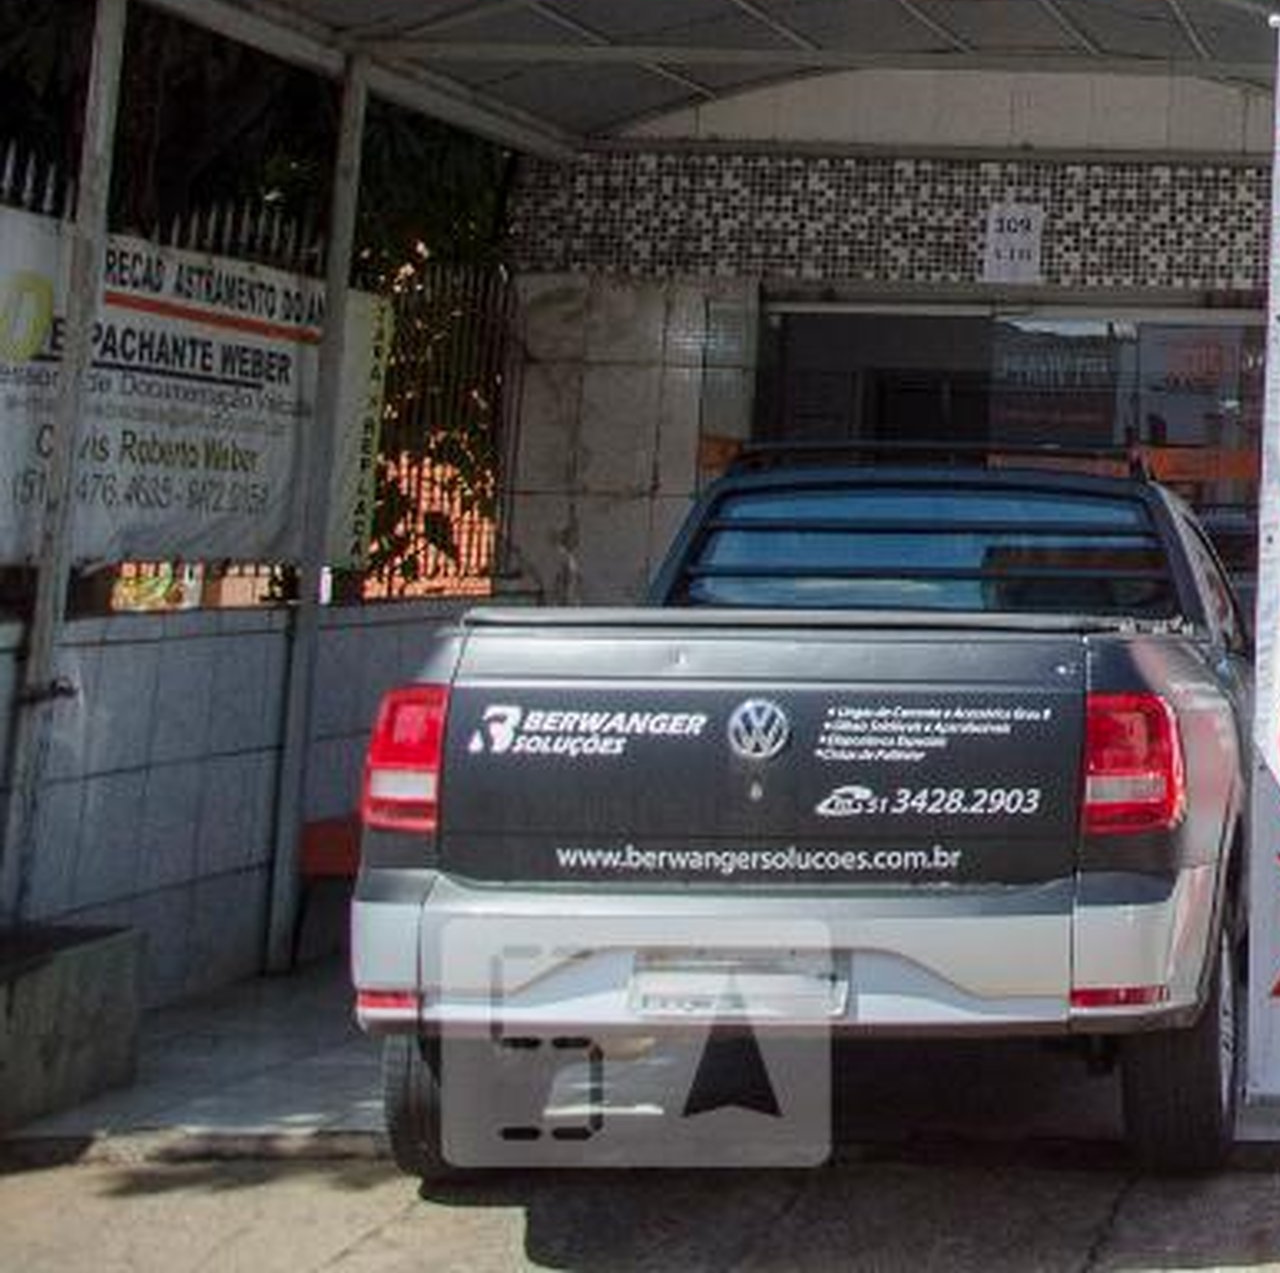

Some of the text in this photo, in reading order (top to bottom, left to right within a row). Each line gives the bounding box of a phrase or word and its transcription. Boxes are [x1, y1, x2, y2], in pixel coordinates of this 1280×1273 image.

[220, 343, 294, 385] WEBER
[522, 710, 708, 737] BERWANGER
[511, 732, 628, 758] SOLUÇÕES
[891, 788, 1041, 814] 3428.2903
[557, 844, 961, 875] www.berwangersolucoes.com.br
